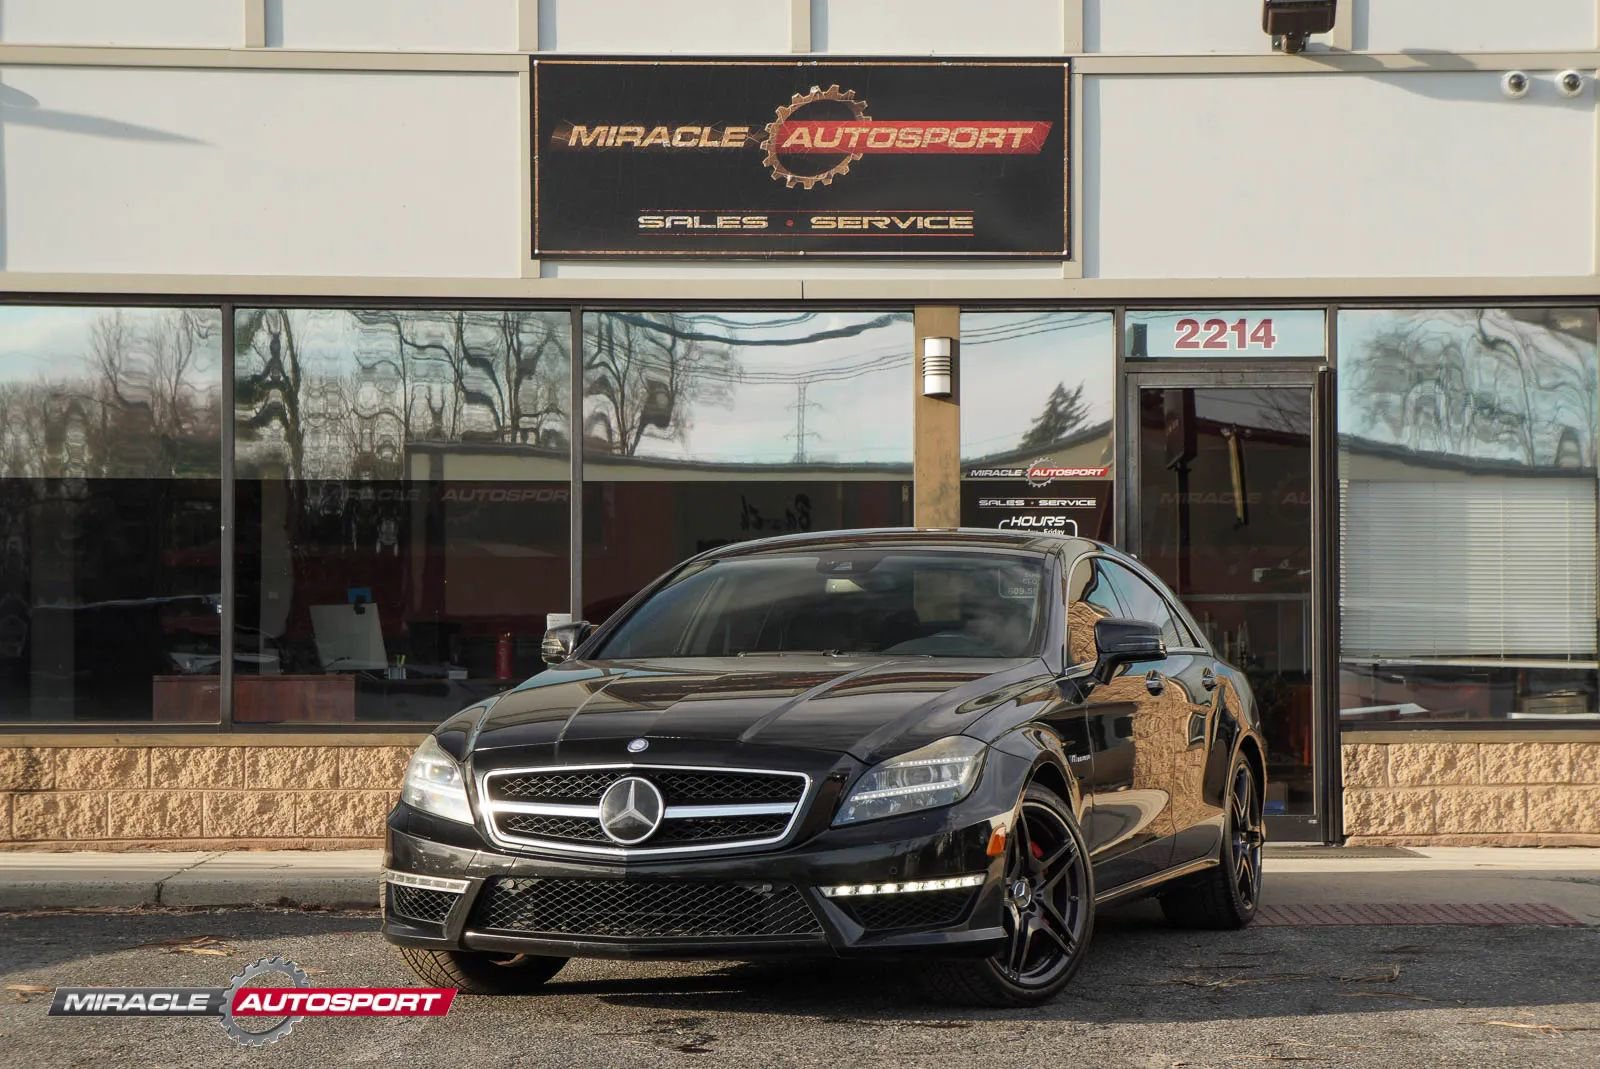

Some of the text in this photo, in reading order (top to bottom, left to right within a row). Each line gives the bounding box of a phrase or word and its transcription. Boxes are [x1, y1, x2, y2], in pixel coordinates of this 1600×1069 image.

[568, 125, 1034, 149] MIRACLE AUTOSPORT
[638, 215, 974, 230] SALES SERVICE
[1174, 318, 1277, 350] 2214
[970, 468, 1105, 477] MIRACLE AUTOSPORT
[441, 488, 569, 502] AUTOSPOR
[978, 499, 1097, 507] SALES SERVICE
[1010, 516, 1066, 526] HOURS
